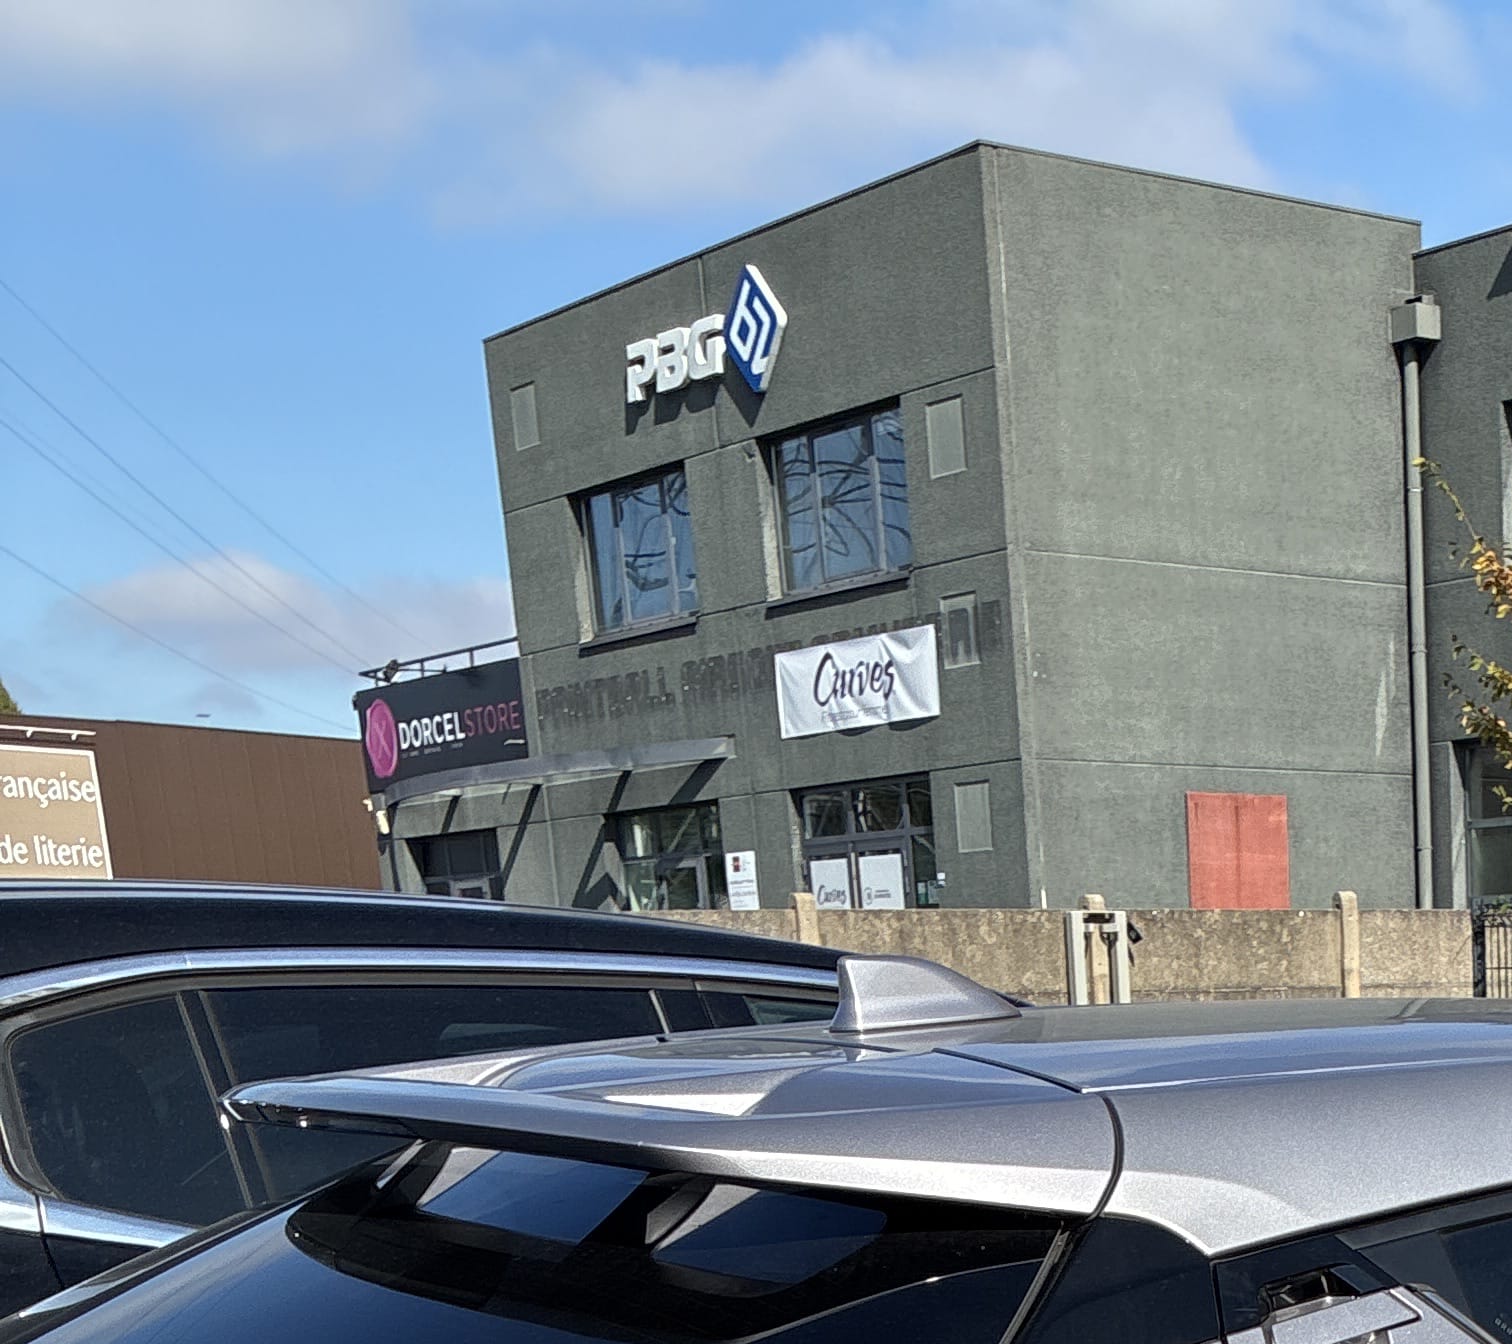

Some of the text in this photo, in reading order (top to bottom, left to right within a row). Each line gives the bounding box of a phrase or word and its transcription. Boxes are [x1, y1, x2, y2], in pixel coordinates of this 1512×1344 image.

[626, 314, 727, 403] PBG
[813, 651, 894, 708] Curves
[397, 700, 522, 751] DORCELSTORE
[0, 833, 104, 868] de literie
